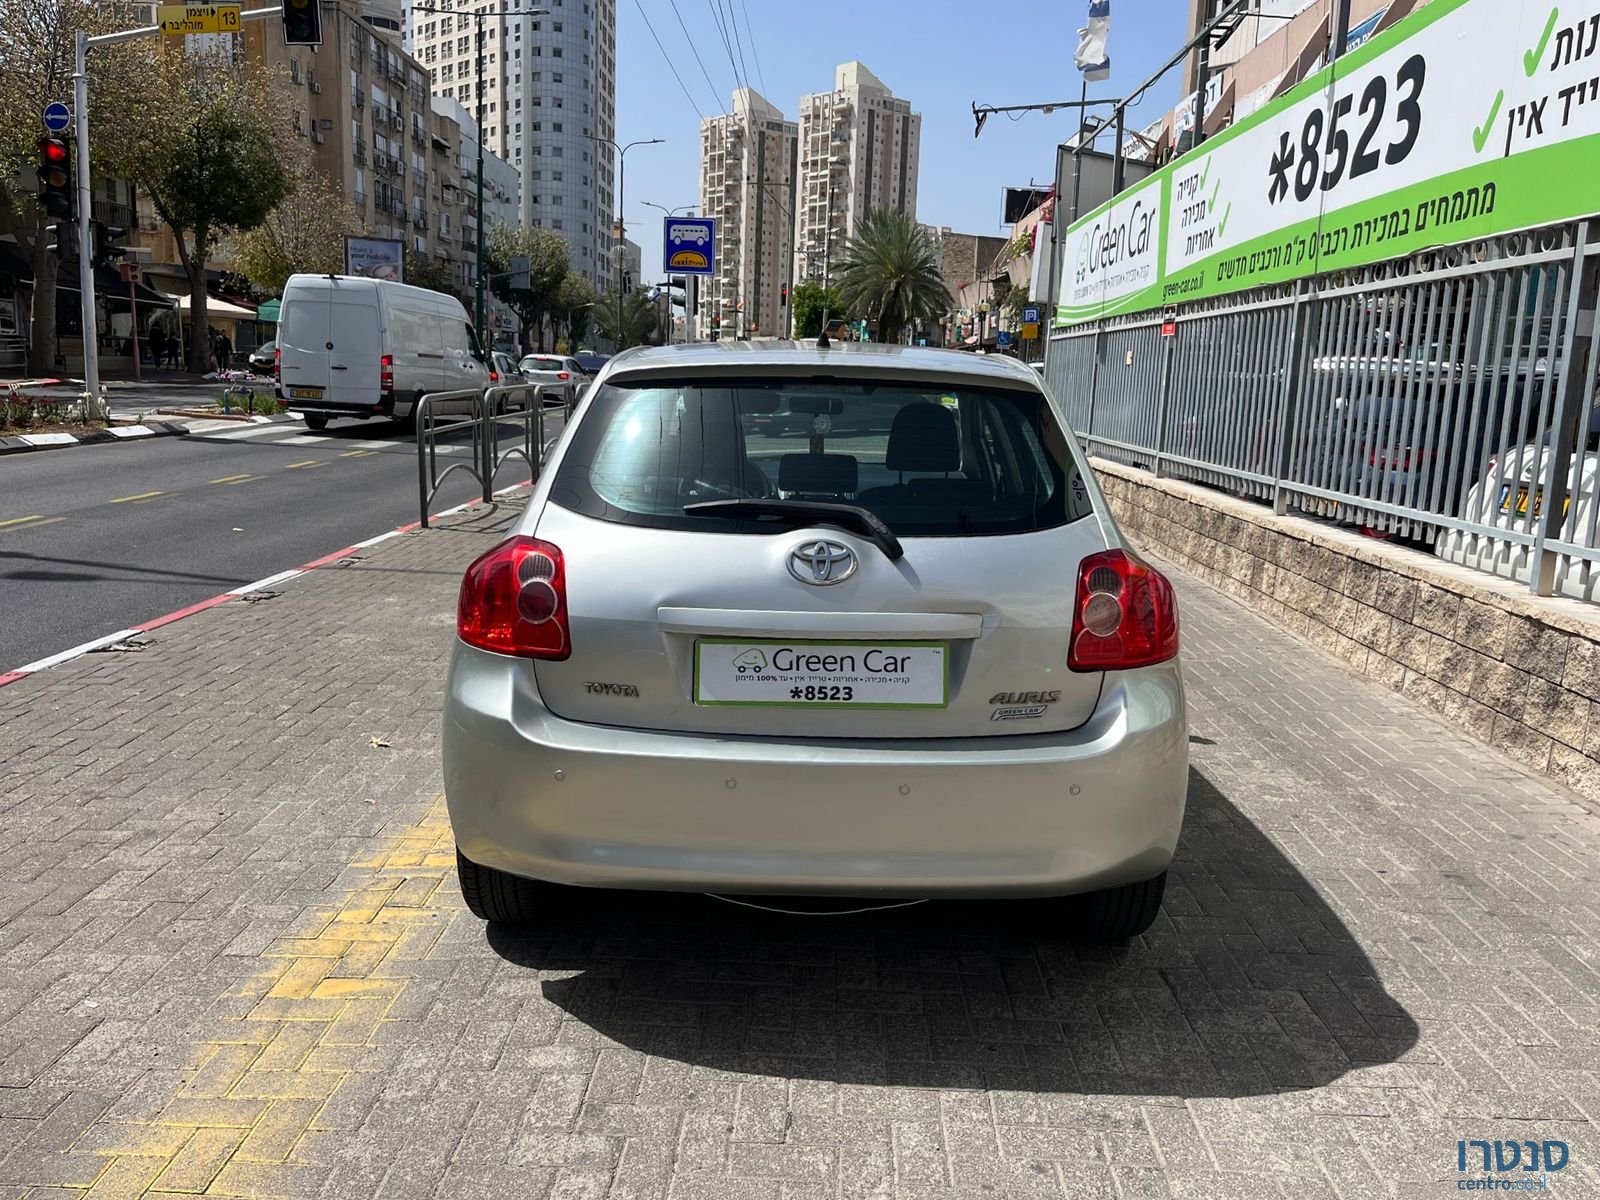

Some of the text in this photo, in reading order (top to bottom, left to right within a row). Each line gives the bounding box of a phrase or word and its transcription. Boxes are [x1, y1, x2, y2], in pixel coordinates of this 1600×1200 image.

[169, 19, 203, 30] מוהליבר
[186, 7, 209, 20] ויצמן
[222, 12, 237, 25] 13
[1504, 96, 1548, 158] אין
[1177, 172, 1199, 201] קנייה
[1181, 199, 1206, 228] מכירה
[1415, 181, 1496, 232] מתמחים
[1089, 200, 1156, 274] Green Car
[1184, 226, 1215, 257] אחריות
[1320, 226, 1347, 257] רכבי
[1350, 208, 1410, 250] במכירת
[1248, 245, 1282, 274] ורכבים
[1308, 231, 1317, 260] 0
[1217, 256, 1247, 282] חדשים
[1162, 270, 1204, 302] green-car.co.il
[772, 648, 911, 673] Green Car
[583, 681, 640, 698] TOYOTA
[735, 674, 754, 682] מימון
[988, 690, 1061, 705] AURIS
